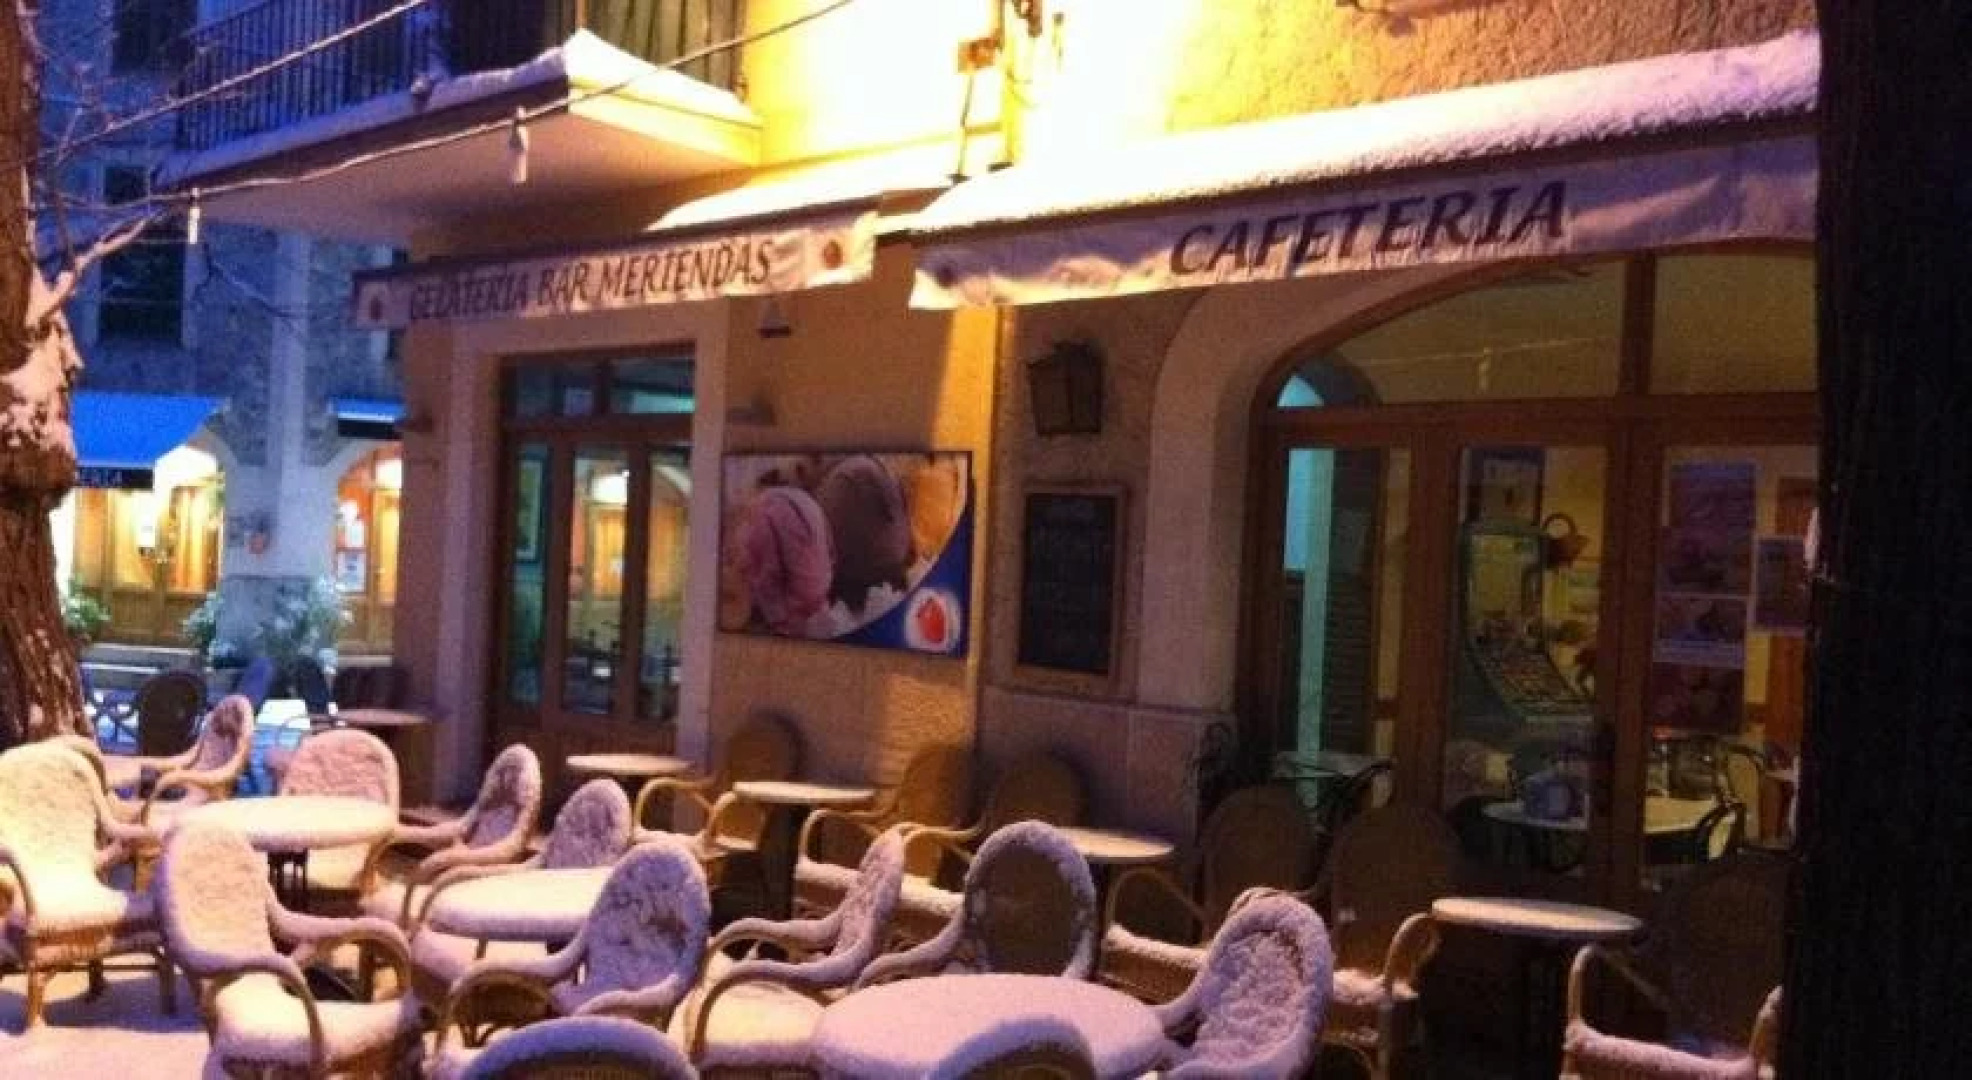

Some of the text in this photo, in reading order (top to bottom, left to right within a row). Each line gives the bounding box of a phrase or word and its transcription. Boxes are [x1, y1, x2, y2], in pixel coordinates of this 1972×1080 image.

[1169, 180, 1567, 276] CAFETERIA
[410, 239, 773, 318] GELATERIA BAR MERIENDAS
